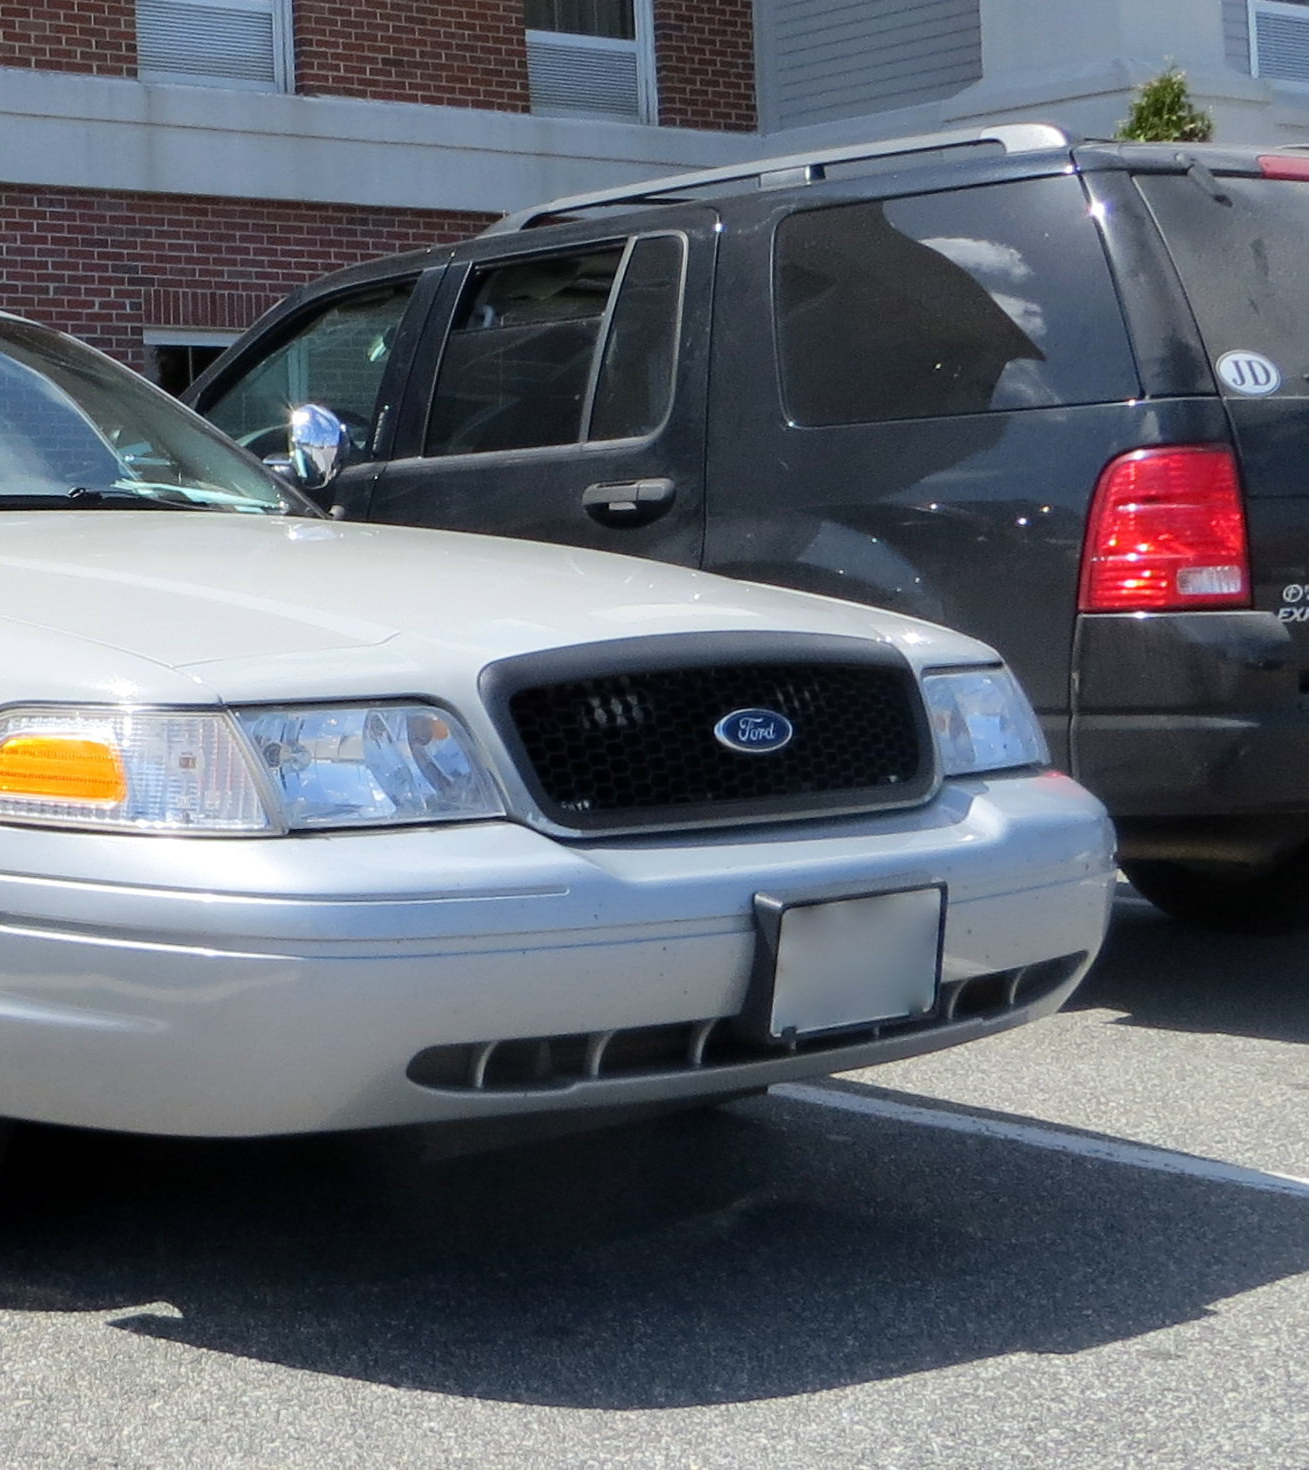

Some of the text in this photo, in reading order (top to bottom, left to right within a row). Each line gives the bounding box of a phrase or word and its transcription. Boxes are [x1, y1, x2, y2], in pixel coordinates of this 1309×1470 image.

[1231, 360, 1271, 386] JD
[1278, 606, 1309, 622] EX
[738, 717, 776, 741] Ford
